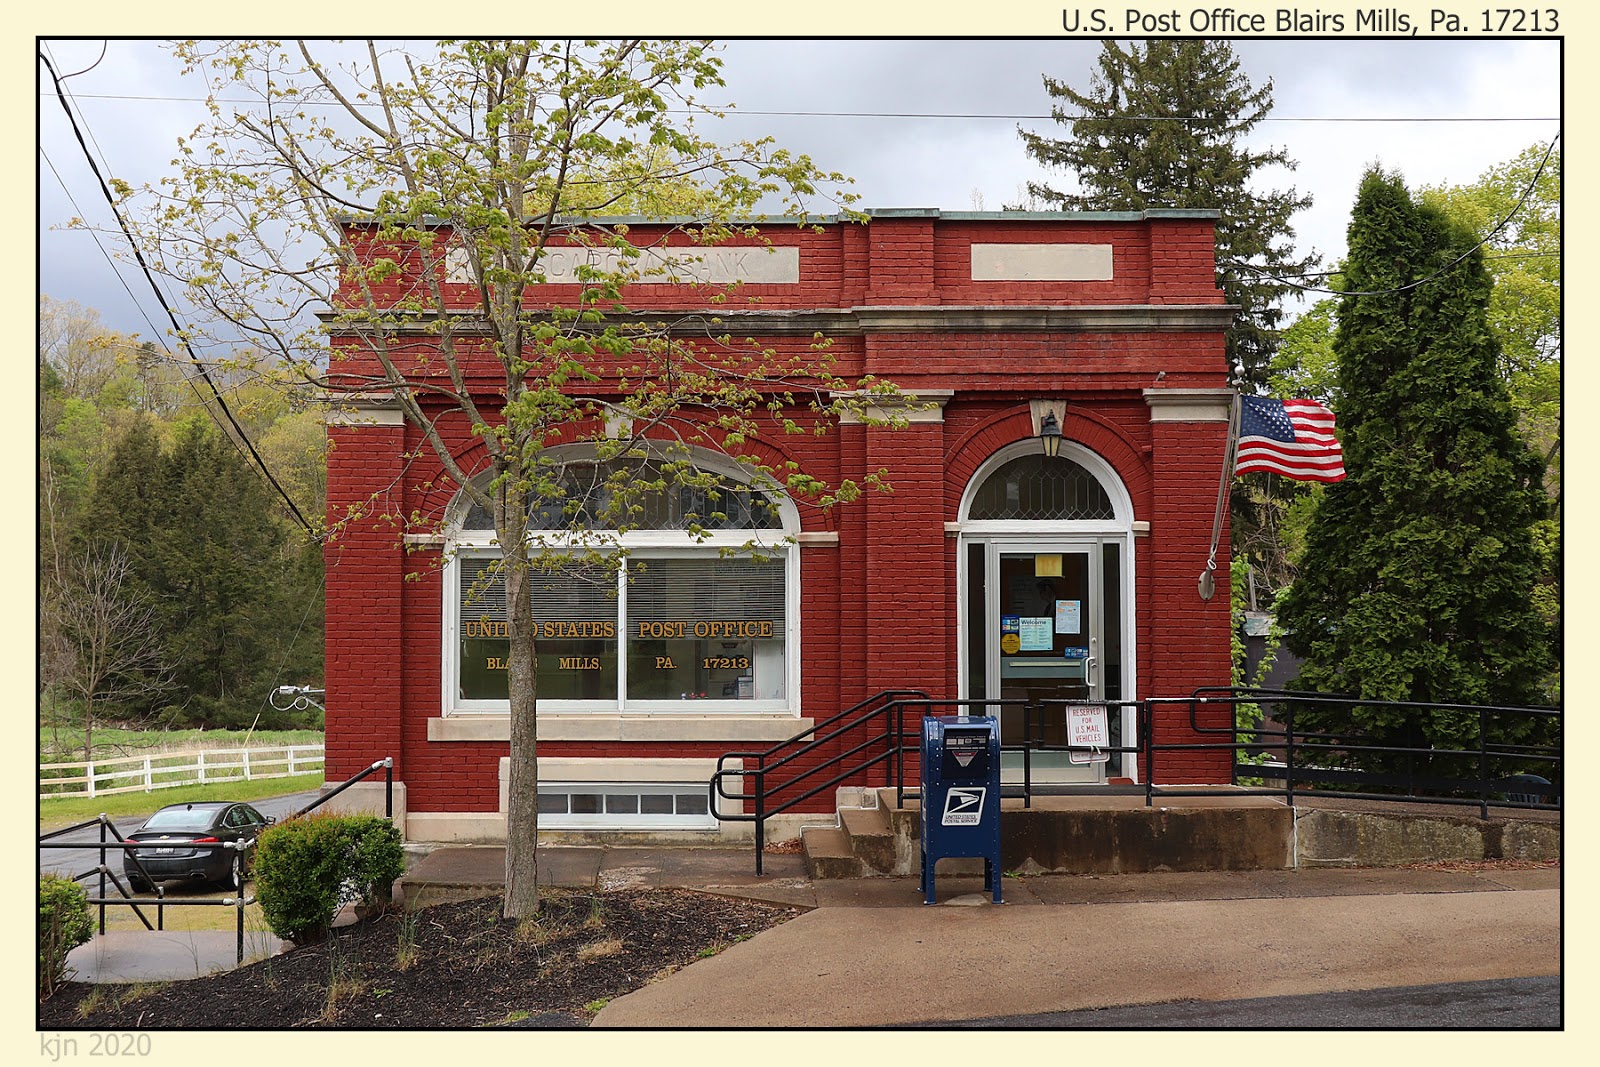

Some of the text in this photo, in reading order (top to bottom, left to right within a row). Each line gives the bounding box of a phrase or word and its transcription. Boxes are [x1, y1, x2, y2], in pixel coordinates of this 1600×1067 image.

[680, 252, 750, 277] BANK
[543, 621, 616, 638] STATES
[638, 621, 688, 638] POST
[694, 620, 773, 637] OFFICE
[558, 657, 602, 671] MILLS,
[655, 656, 678, 669] PA.
[703, 657, 750, 669] 17213
[1073, 707, 1101, 716] RESERVED
[1087, 725, 1100, 733] MAIL
[1076, 734, 1101, 743] VEHICLES
